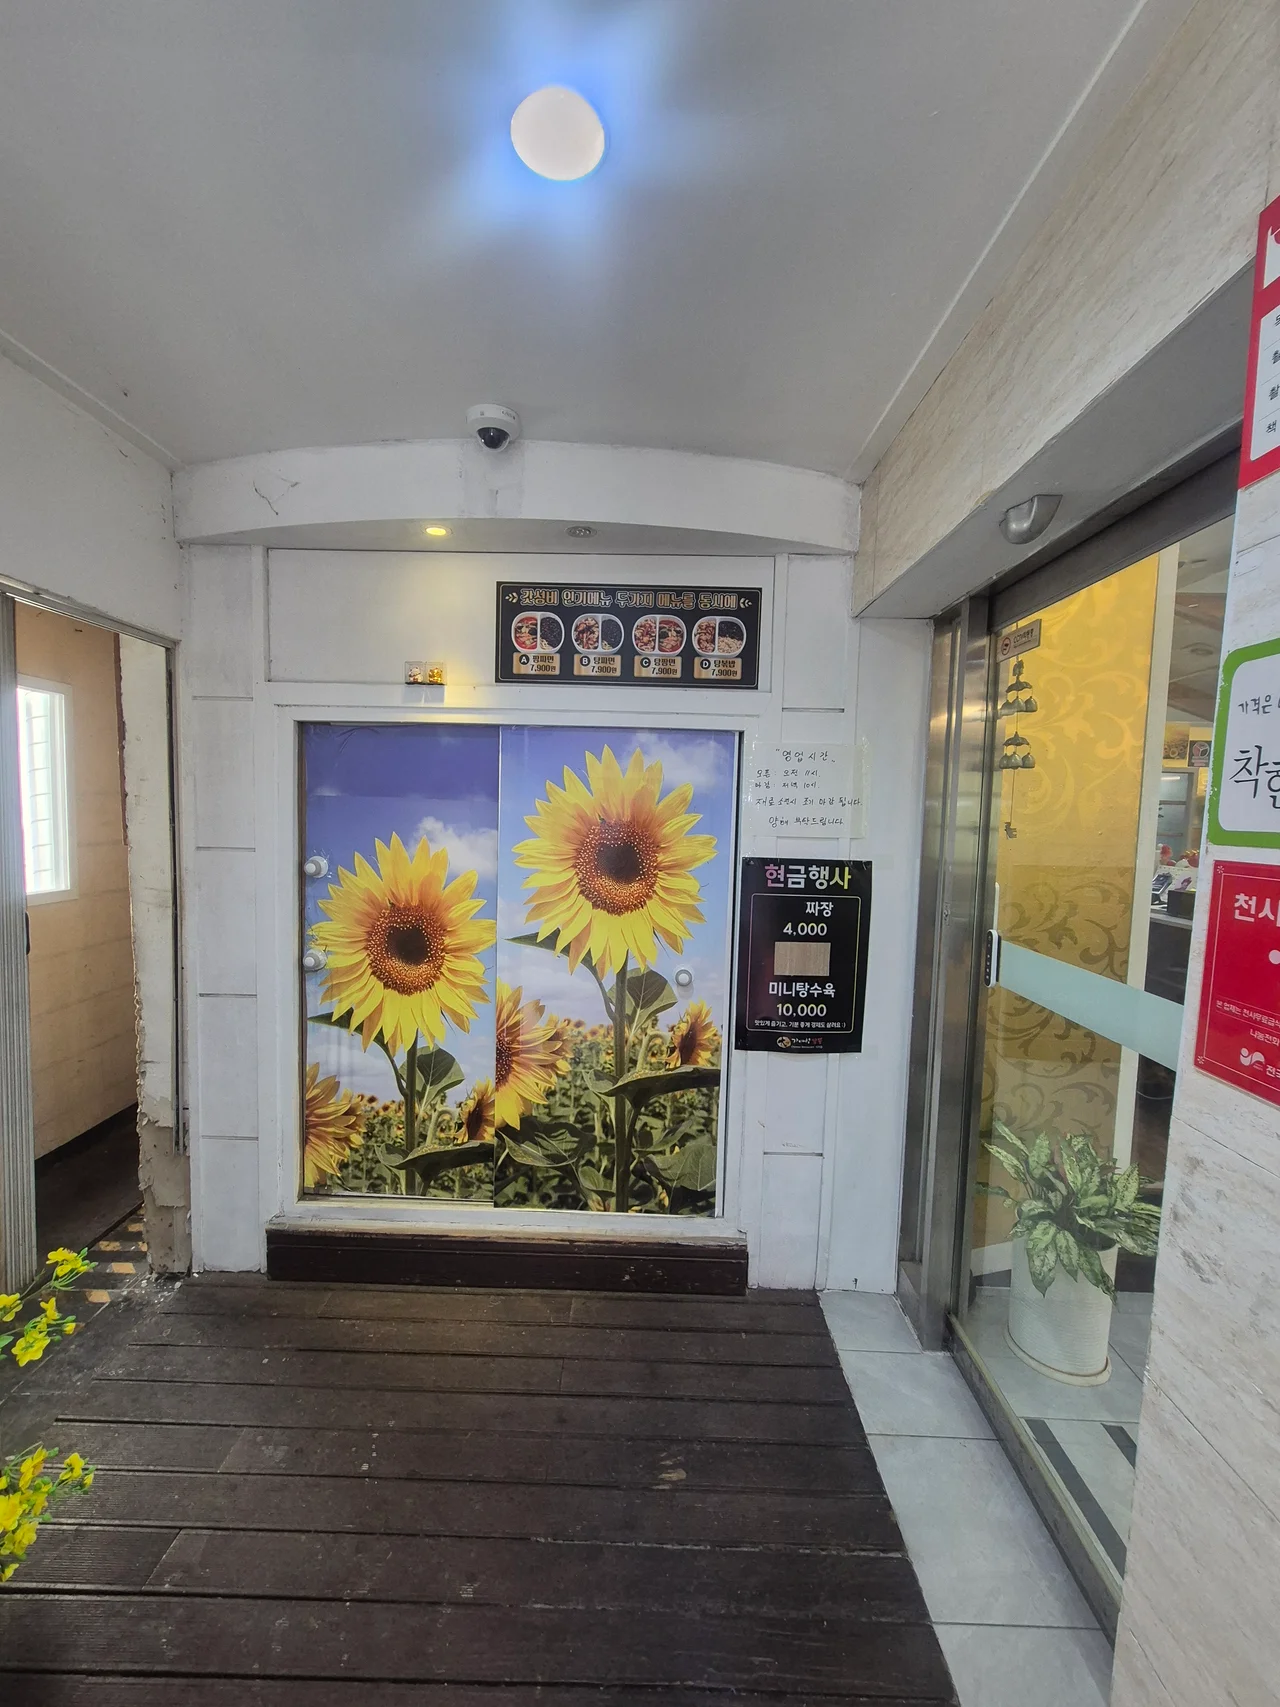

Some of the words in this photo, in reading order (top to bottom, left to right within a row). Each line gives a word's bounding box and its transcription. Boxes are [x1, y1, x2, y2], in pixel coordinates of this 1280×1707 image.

[521, 589, 559, 605] 갓성비
[562, 589, 613, 606] 인기메뉴
[615, 591, 655, 607] 두가지
[657, 592, 695, 609] 메뉴를
[699, 592, 738, 610] 동시에
[520, 655, 529, 665] A
[581, 656, 590, 665] B
[641, 658, 650, 667] C
[700, 659, 710, 669] D
[1238, 694, 1272, 715] 가격은
[768, 816, 789, 828] 양해
[765, 864, 851, 890] 현금행사
[806, 901, 834, 917] 짜장
[783, 922, 828, 936] 4,000
[769, 982, 836, 998] 미니탕수육
[776, 1003, 827, 1017] 10,000
